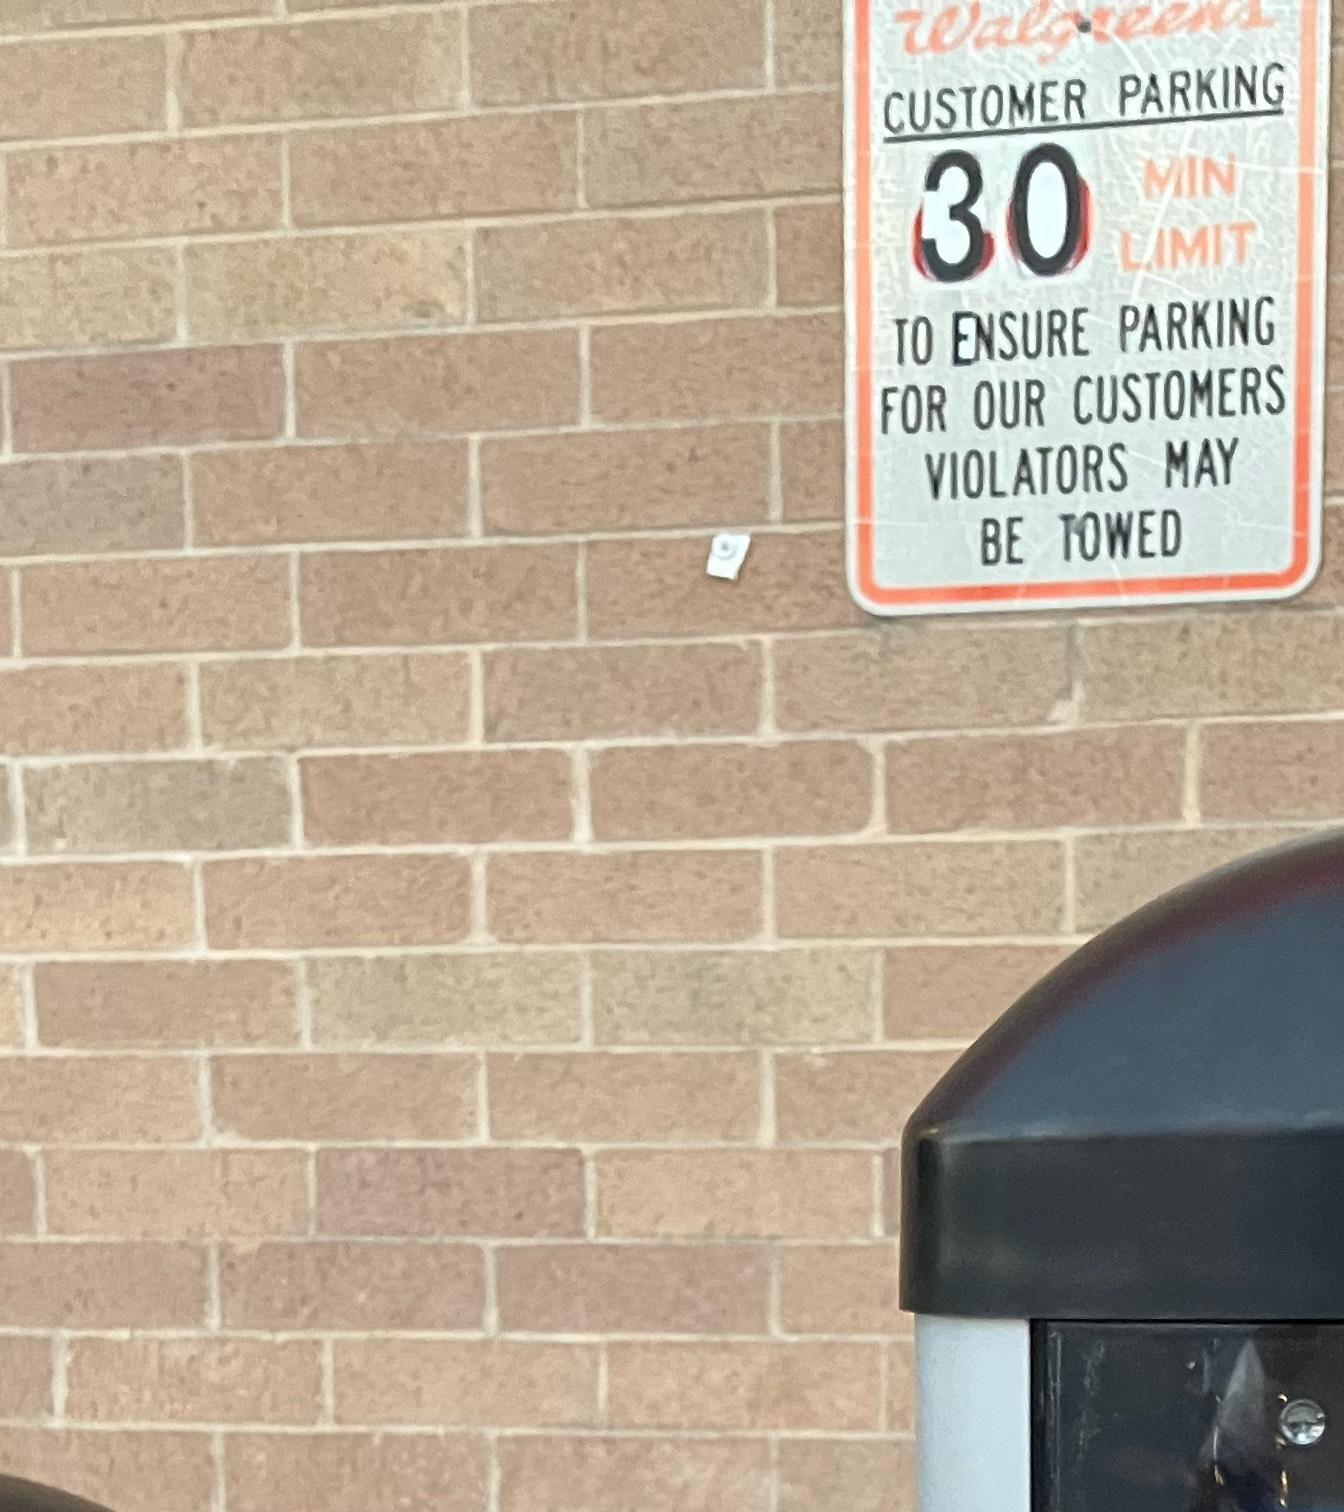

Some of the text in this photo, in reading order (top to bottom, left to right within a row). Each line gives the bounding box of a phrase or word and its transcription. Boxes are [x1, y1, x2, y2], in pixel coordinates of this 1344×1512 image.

[883, 61, 1286, 134] CUSTOMER PARKING
[1143, 153, 1238, 202] MIN
[918, 142, 1086, 284] 30
[1120, 221, 1256, 273] LIMIT
[894, 295, 1276, 368] TO ENSURE PARKING
[880, 364, 1287, 435] FOR OUR CUSTOMERS
[924, 436, 1240, 501] VIOLATORS MAY
[980, 508, 1182, 567] BE TOWED
